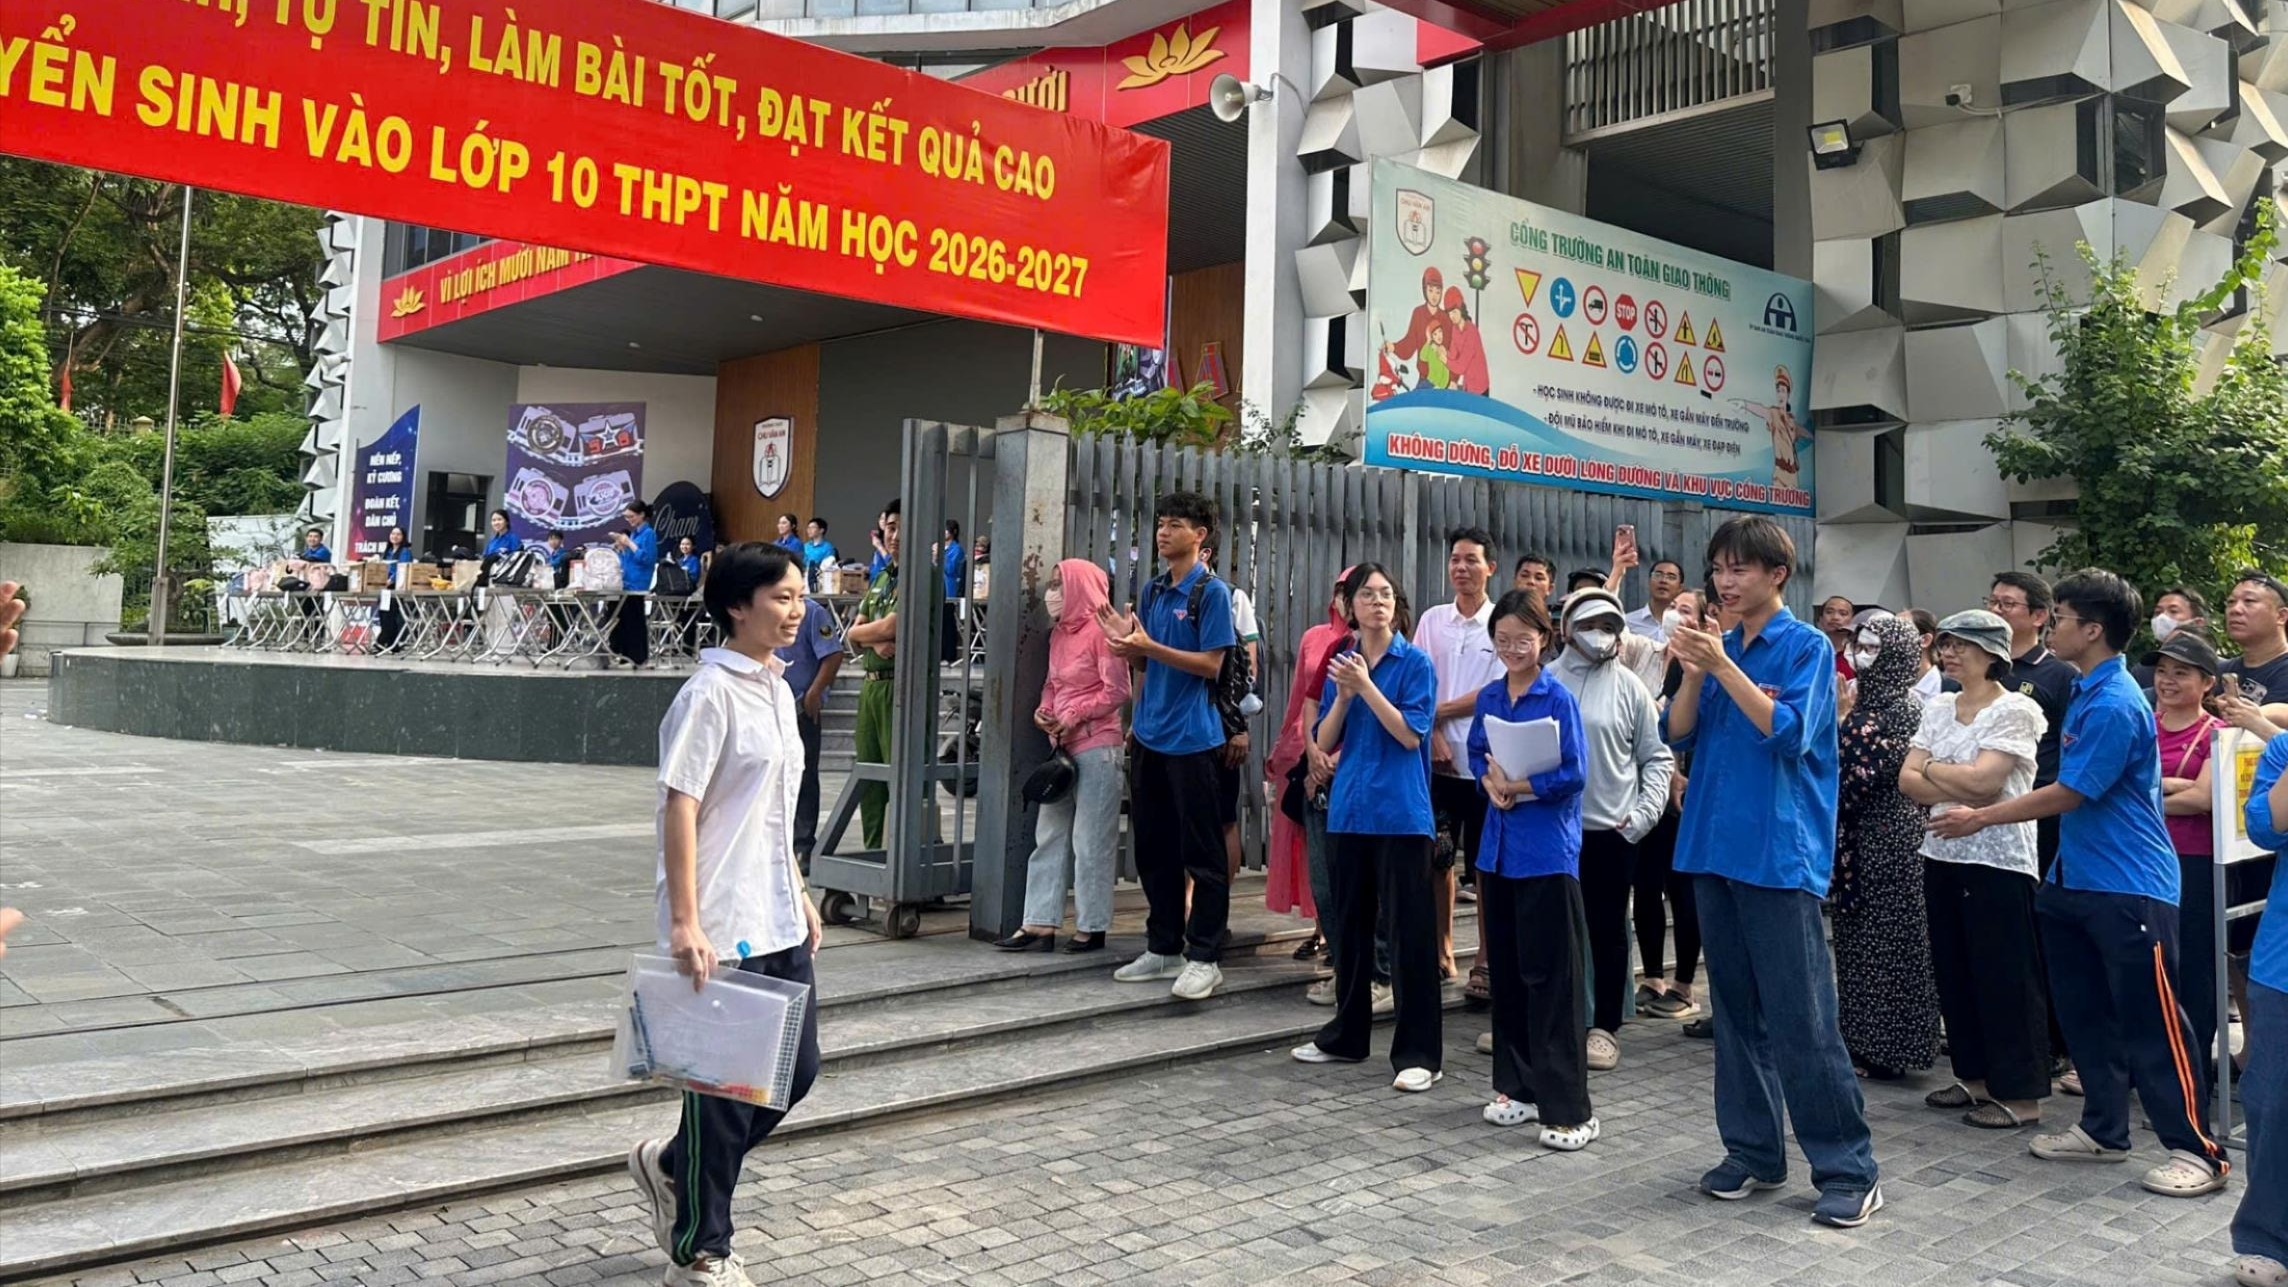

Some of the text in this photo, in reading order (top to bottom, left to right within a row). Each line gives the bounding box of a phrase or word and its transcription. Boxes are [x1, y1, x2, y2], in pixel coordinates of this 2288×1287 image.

[360, 0, 450, 73] TIN,
[469, 9, 561, 87] LÀM
[576, 36, 644, 106] BÀI
[660, 54, 745, 140] TỐT,
[758, 88, 830, 156] ĐẠT
[843, 98, 908, 164] KẾT
[919, 121, 985, 185] QUẢ
[993, 145, 1055, 200] CAO
[136, 66, 282, 148] SINH
[303, 93, 412, 173] VÀO
[430, 120, 529, 193] LỚP
[547, 152, 598, 208] 10
[613, 164, 728, 231] THPT
[741, 184, 828, 251] NĂM
[841, 210, 917, 274] HỌC
[929, 229, 1088, 298] 2026-2027
[440, 270, 452, 303] VÌ
[454, 268, 473, 304] LỢI
[475, 259, 496, 293] ÍCH
[499, 243, 533, 285] MƯỜI
[1510, 218, 1731, 300] CỔNG TRƯỜNG AN TOÀN GIAO THÔNG
[1616, 303, 1636, 320] STOP
[1556, 388, 1574, 401] SINH
[1575, 390, 1602, 406] KHÔNG
[1626, 399, 1634, 411] ĐI
[1635, 401, 1644, 413] XE
[1670, 408, 1679, 420] XE
[1389, 433, 1445, 460] KHÔNG
[1449, 439, 1494, 469] DỪNG,
[1499, 443, 1519, 469] ĐỖ
[1522, 451, 1541, 473] XE
[1544, 453, 1577, 477] DƯỚI
[1580, 456, 1615, 481] LÒNG
[1618, 463, 1661, 487] ĐƯỜNG
[1664, 468, 1680, 490] VÀ
[1683, 474, 1708, 494] KHU
[1710, 477, 1733, 500] VỰC
[1768, 485, 1811, 507] TRƯỜNG
